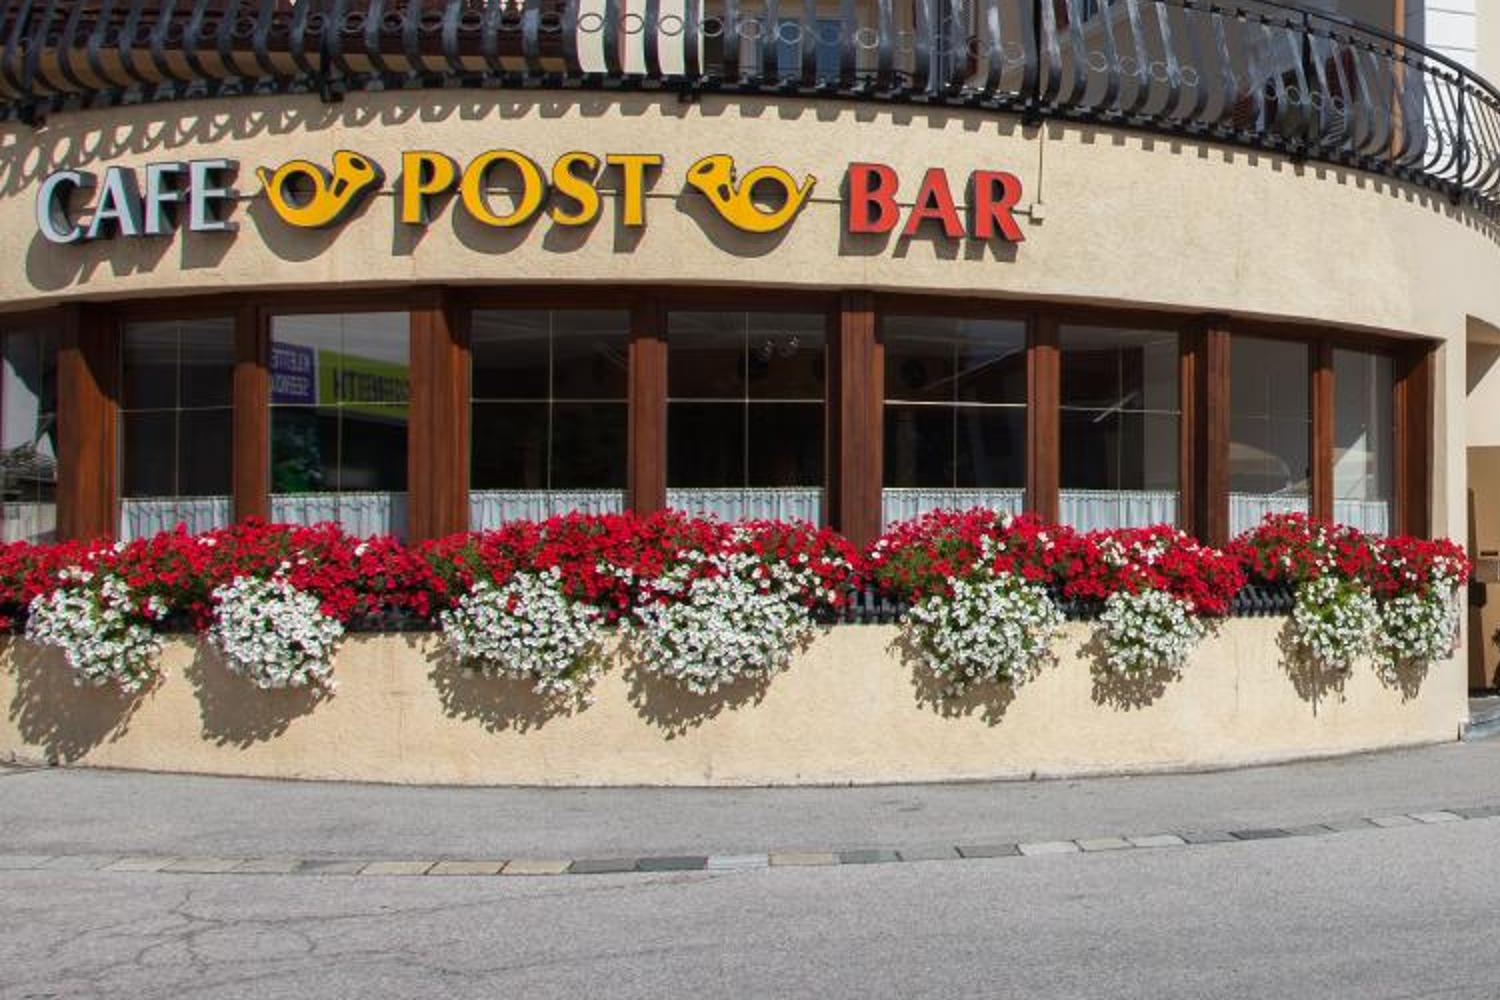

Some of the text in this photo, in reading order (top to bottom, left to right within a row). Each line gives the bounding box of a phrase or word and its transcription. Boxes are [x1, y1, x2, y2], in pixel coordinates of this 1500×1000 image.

[35, 149, 1026, 245] CAFE POST BAR
